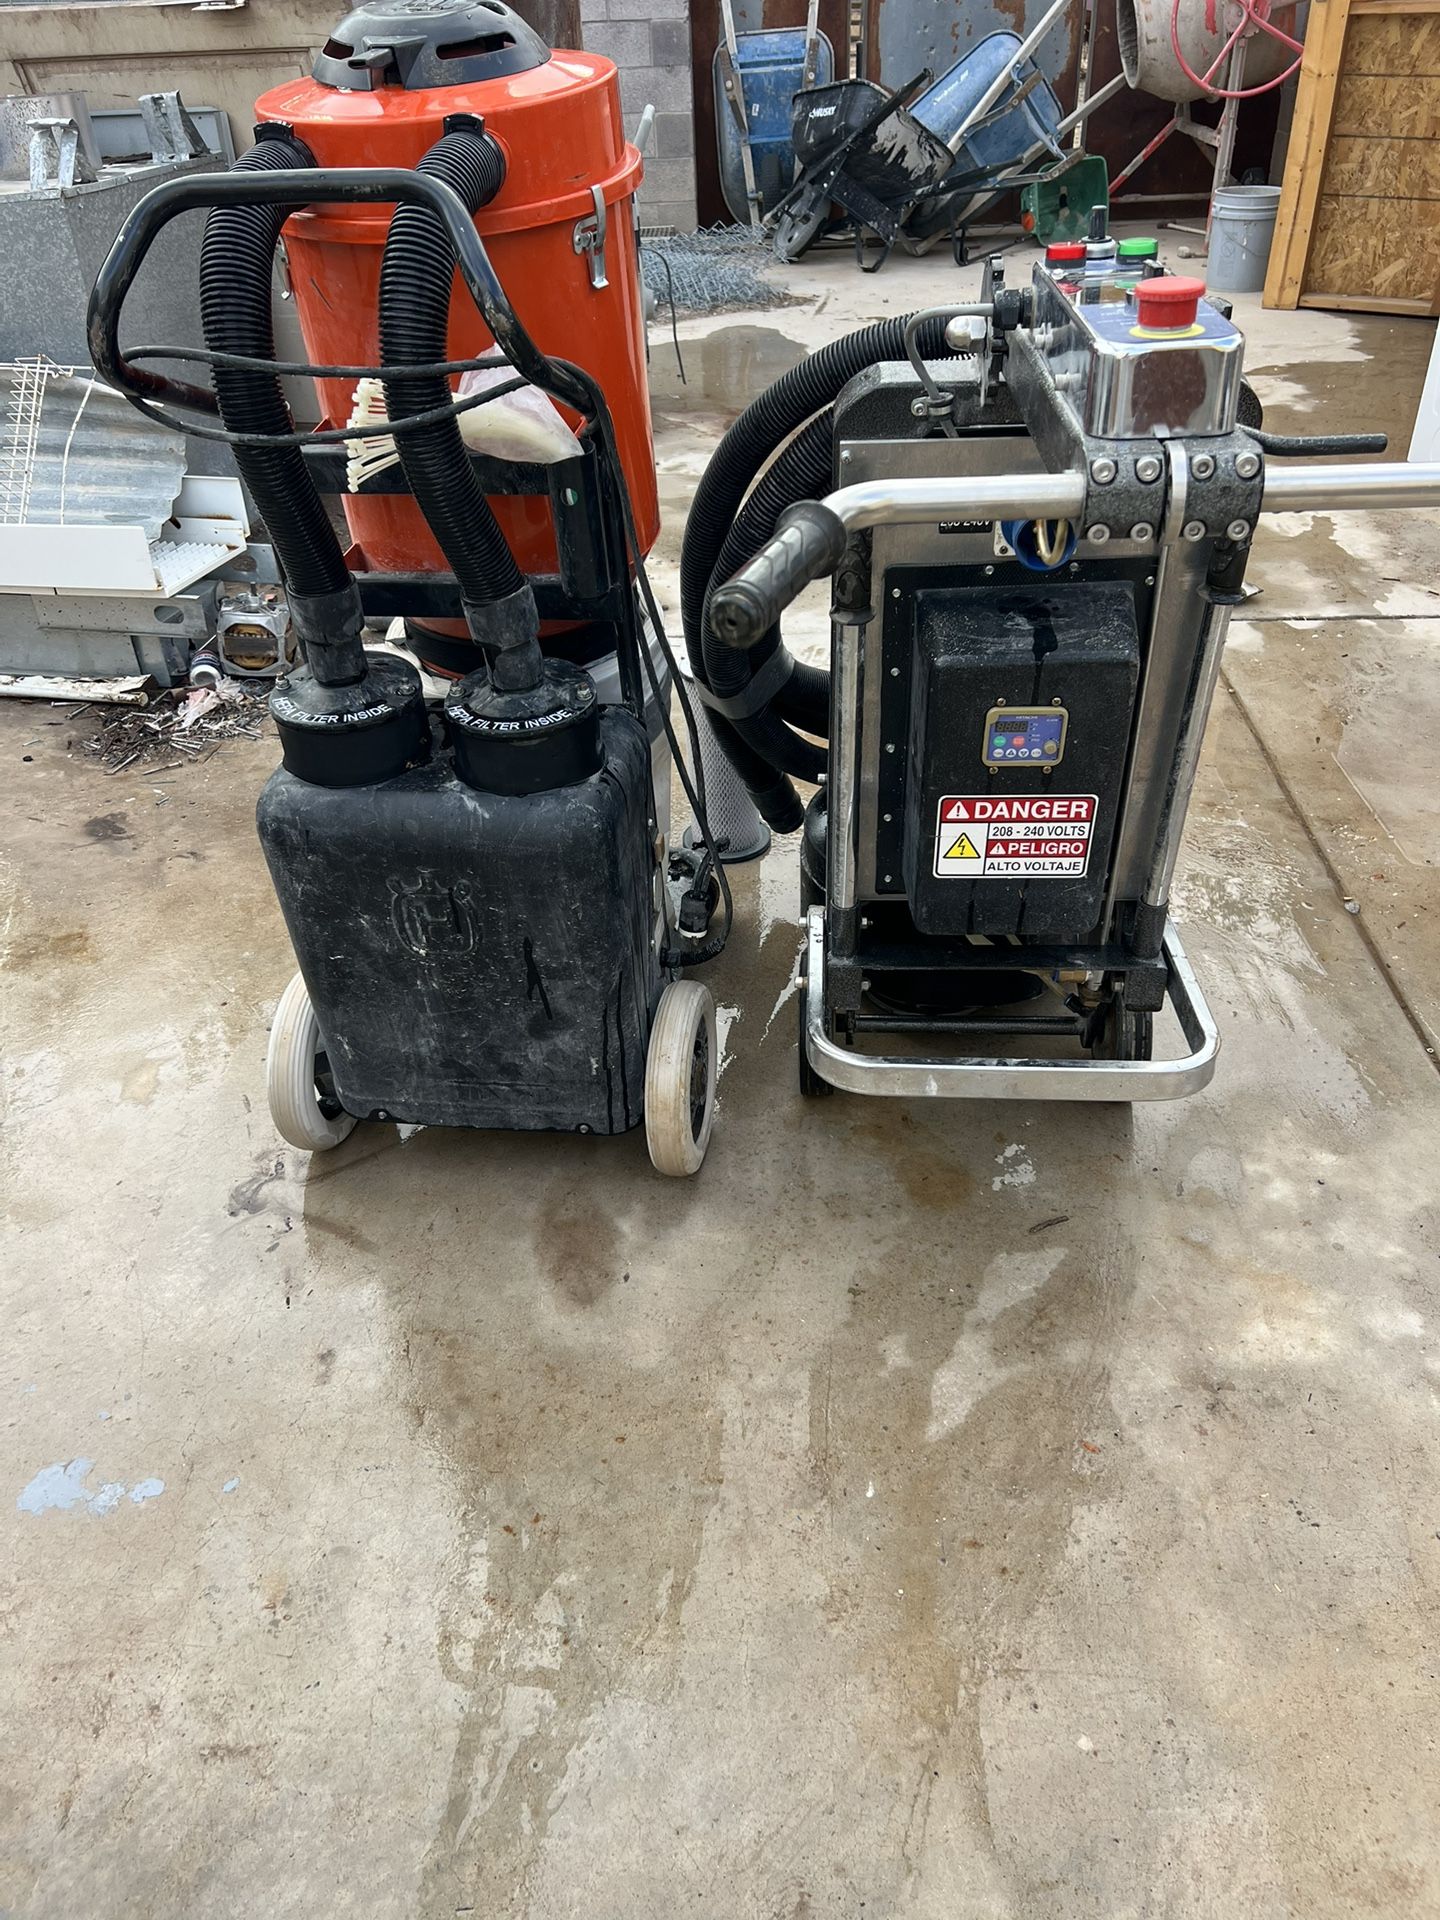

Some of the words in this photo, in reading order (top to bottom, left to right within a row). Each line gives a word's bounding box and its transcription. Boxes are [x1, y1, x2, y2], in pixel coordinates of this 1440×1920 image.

[272, 696, 298, 716] HEPA
[291, 711, 338, 724] FILTER
[343, 703, 392, 723] INSIDE
[448, 705, 474, 724] HEPA
[471, 718, 520, 731] FILTER
[525, 709, 572, 729] INSIDE
[974, 801, 1089, 819] DANGER
[992, 826, 1013, 837] 208
[1023, 826, 1044, 837] 240
[1047, 825, 1086, 837] VOLTS
[1007, 842, 1084, 855] PELIGRO
[987, 861, 1021, 871] ALTO
[1023, 861, 1081, 871] VOLTAJE
